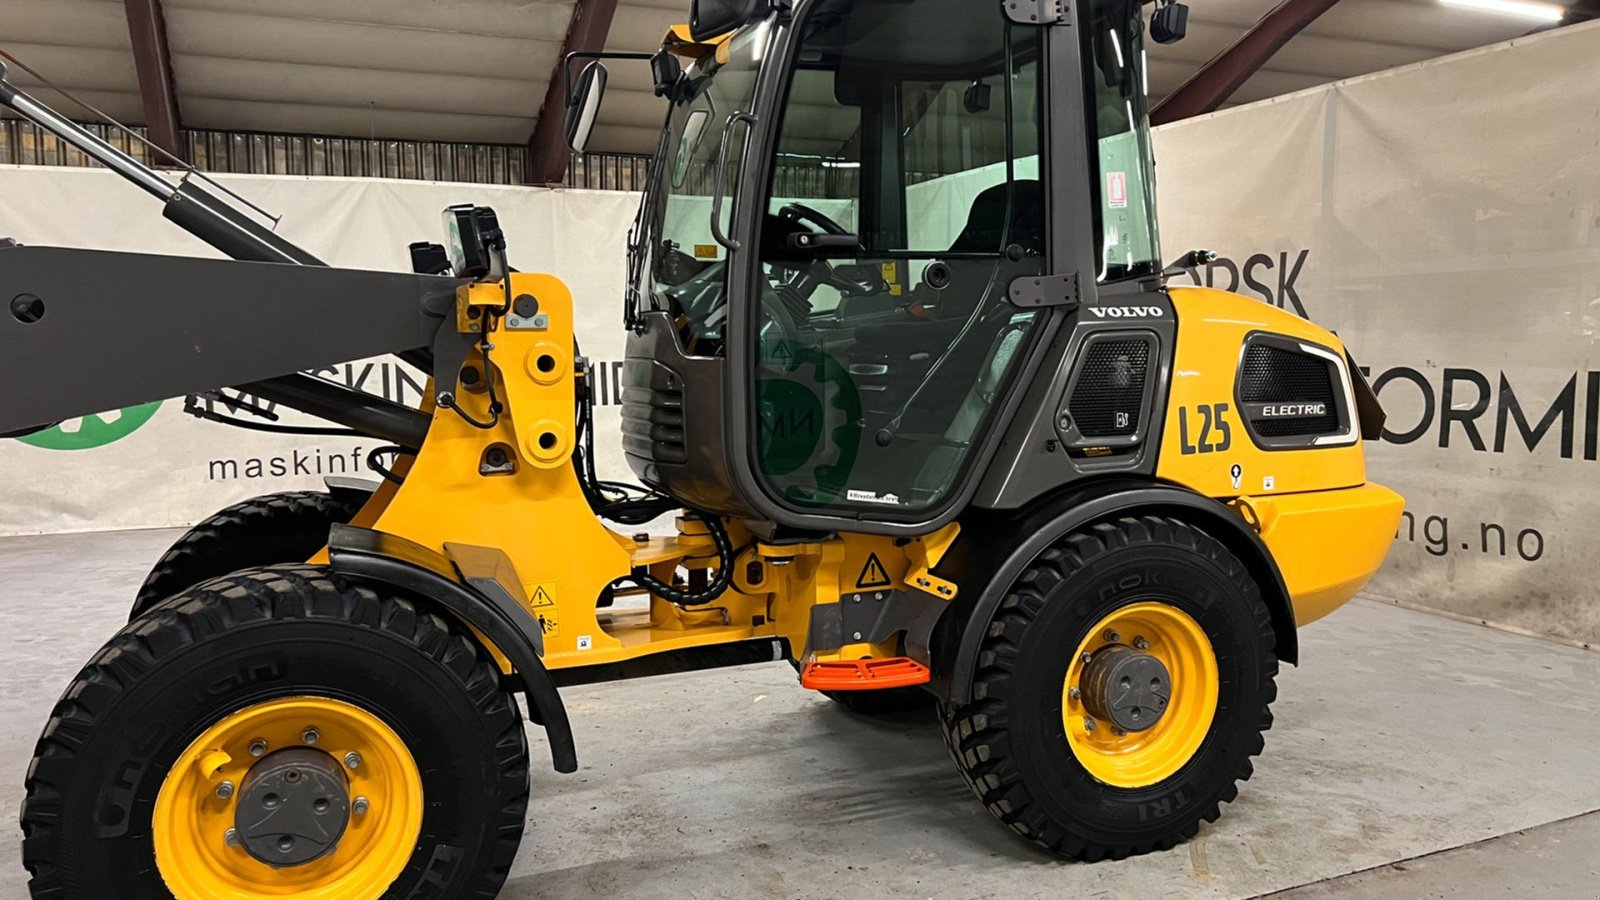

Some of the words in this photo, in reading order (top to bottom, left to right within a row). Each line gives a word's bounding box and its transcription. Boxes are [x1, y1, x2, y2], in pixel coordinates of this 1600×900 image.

[1087, 306, 1164, 318] VOLVO
[1262, 404, 1326, 416] ELECTRIC
[1358, 366, 1600, 461] ORMI
[1178, 402, 1232, 455] L25
